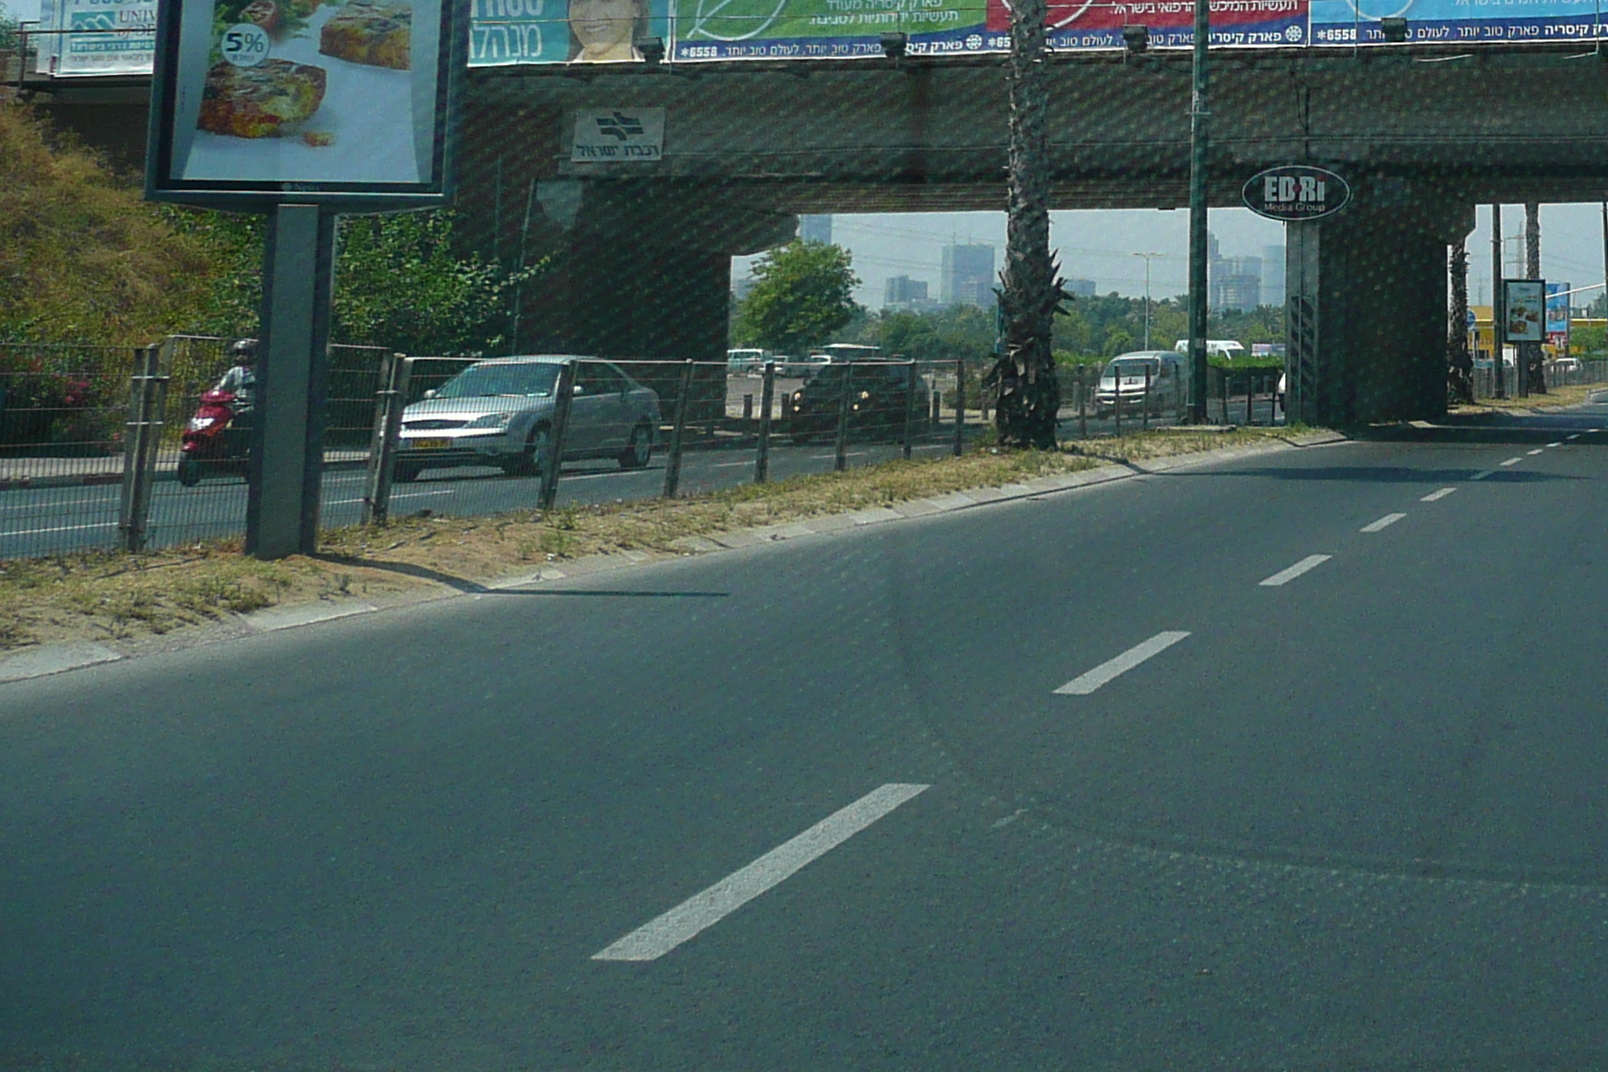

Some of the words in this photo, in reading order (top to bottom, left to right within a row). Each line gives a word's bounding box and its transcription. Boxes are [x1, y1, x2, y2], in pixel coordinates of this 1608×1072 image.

[1417, 25, 1449, 38] לעולם
[1484, 26, 1503, 36] טוב
[1508, 26, 1539, 38] פארק
[1545, 24, 1589, 37] קיסריה
[226, 33, 264, 53] 5%
[1060, 36, 1078, 47] טוב
[1082, 33, 1113, 47] לעולם
[1248, 31, 1282, 45] פארק
[770, 43, 799, 56] לעולם
[852, 43, 882, 56] פארק
[930, 40, 963, 54] פארק
[576, 144, 619, 157] ישראל
[624, 145, 660, 156] רכבת
[1264, 203, 1292, 212] Media
[1295, 203, 1326, 213] Group
